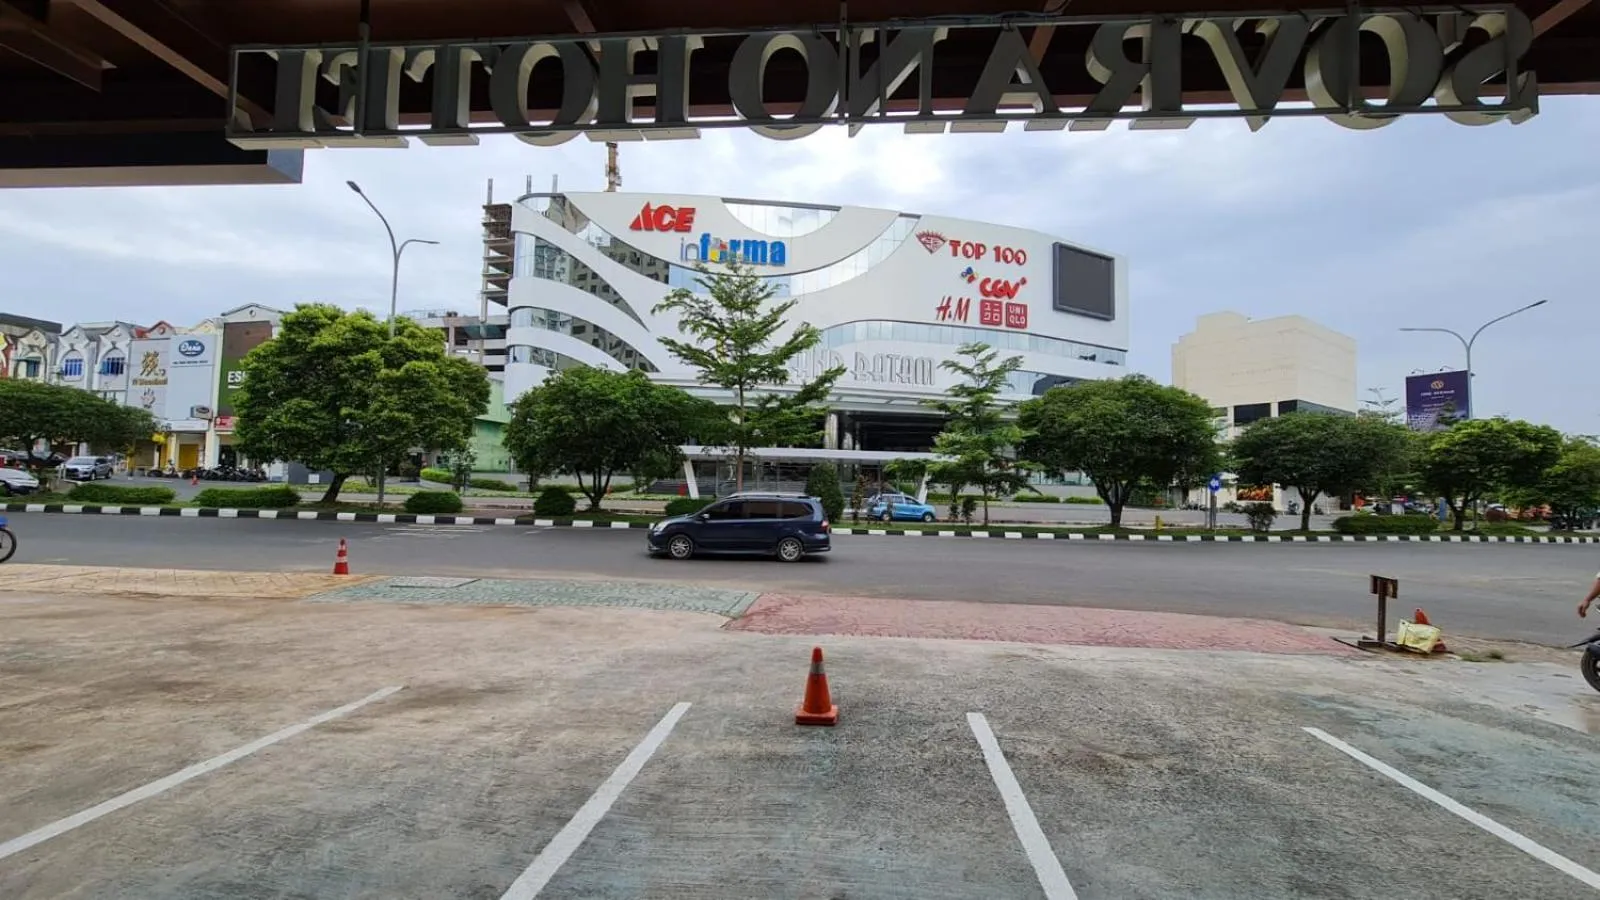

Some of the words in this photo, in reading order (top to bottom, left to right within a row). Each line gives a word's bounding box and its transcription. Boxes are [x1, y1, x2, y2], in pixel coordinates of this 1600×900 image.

[629, 201, 696, 233] ACE
[680, 232, 786, 266] informa
[949, 240, 987, 260] TOP
[993, 245, 1027, 266] 100
[979, 277, 1021, 299] CGV
[850, 351, 937, 386] BATAM
